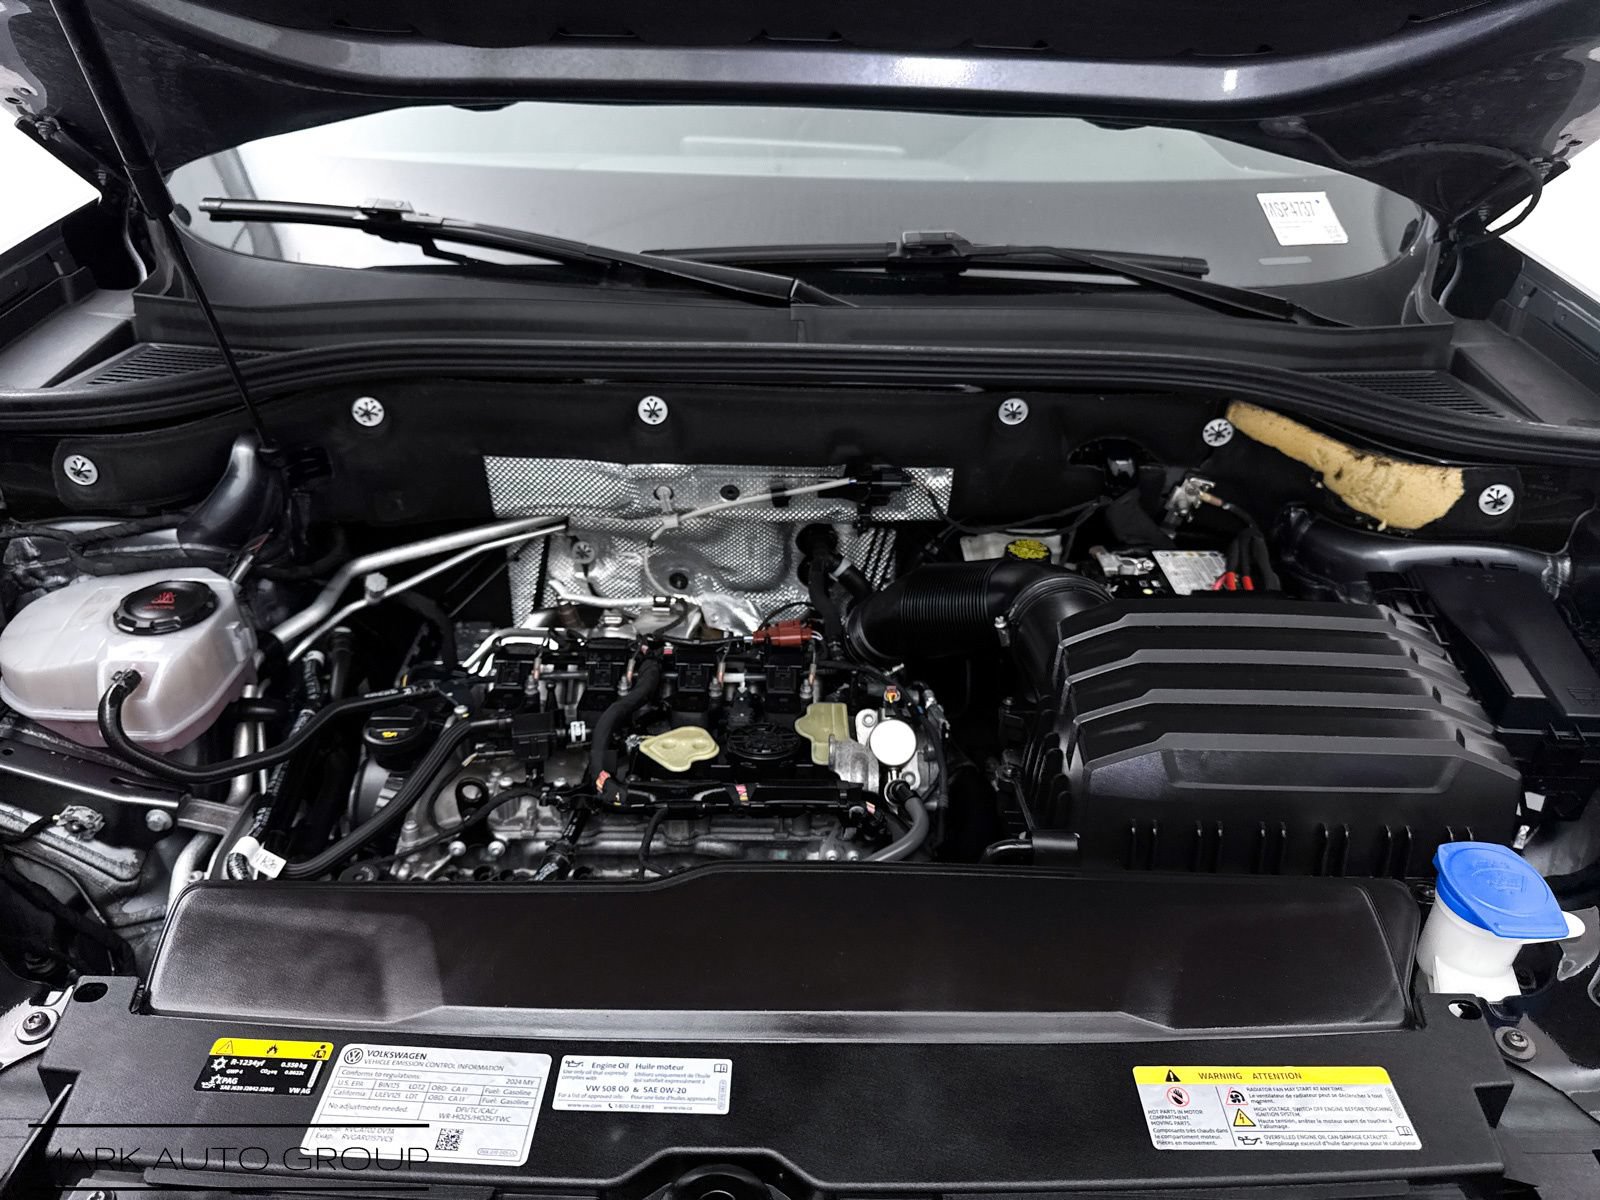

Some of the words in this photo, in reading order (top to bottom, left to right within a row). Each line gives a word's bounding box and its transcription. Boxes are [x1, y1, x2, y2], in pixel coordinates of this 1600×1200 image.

[367, 1050, 427, 1060] VOLKSWAGEN
[299, 1062, 308, 1070] kg
[457, 1063, 504, 1071] INFORMATION
[591, 1062, 617, 1070] Engine
[341, 1069, 373, 1077] Conforms
[1198, 1072, 1243, 1080] WARNING
[1252, 1072, 1303, 1080] ATTENTION
[503, 1088, 532, 1096] Gasoline
[328, 1101, 338, 1109] No
[339, 1102, 381, 1111] adjustments
[500, 1098, 529, 1106] Gasoline
